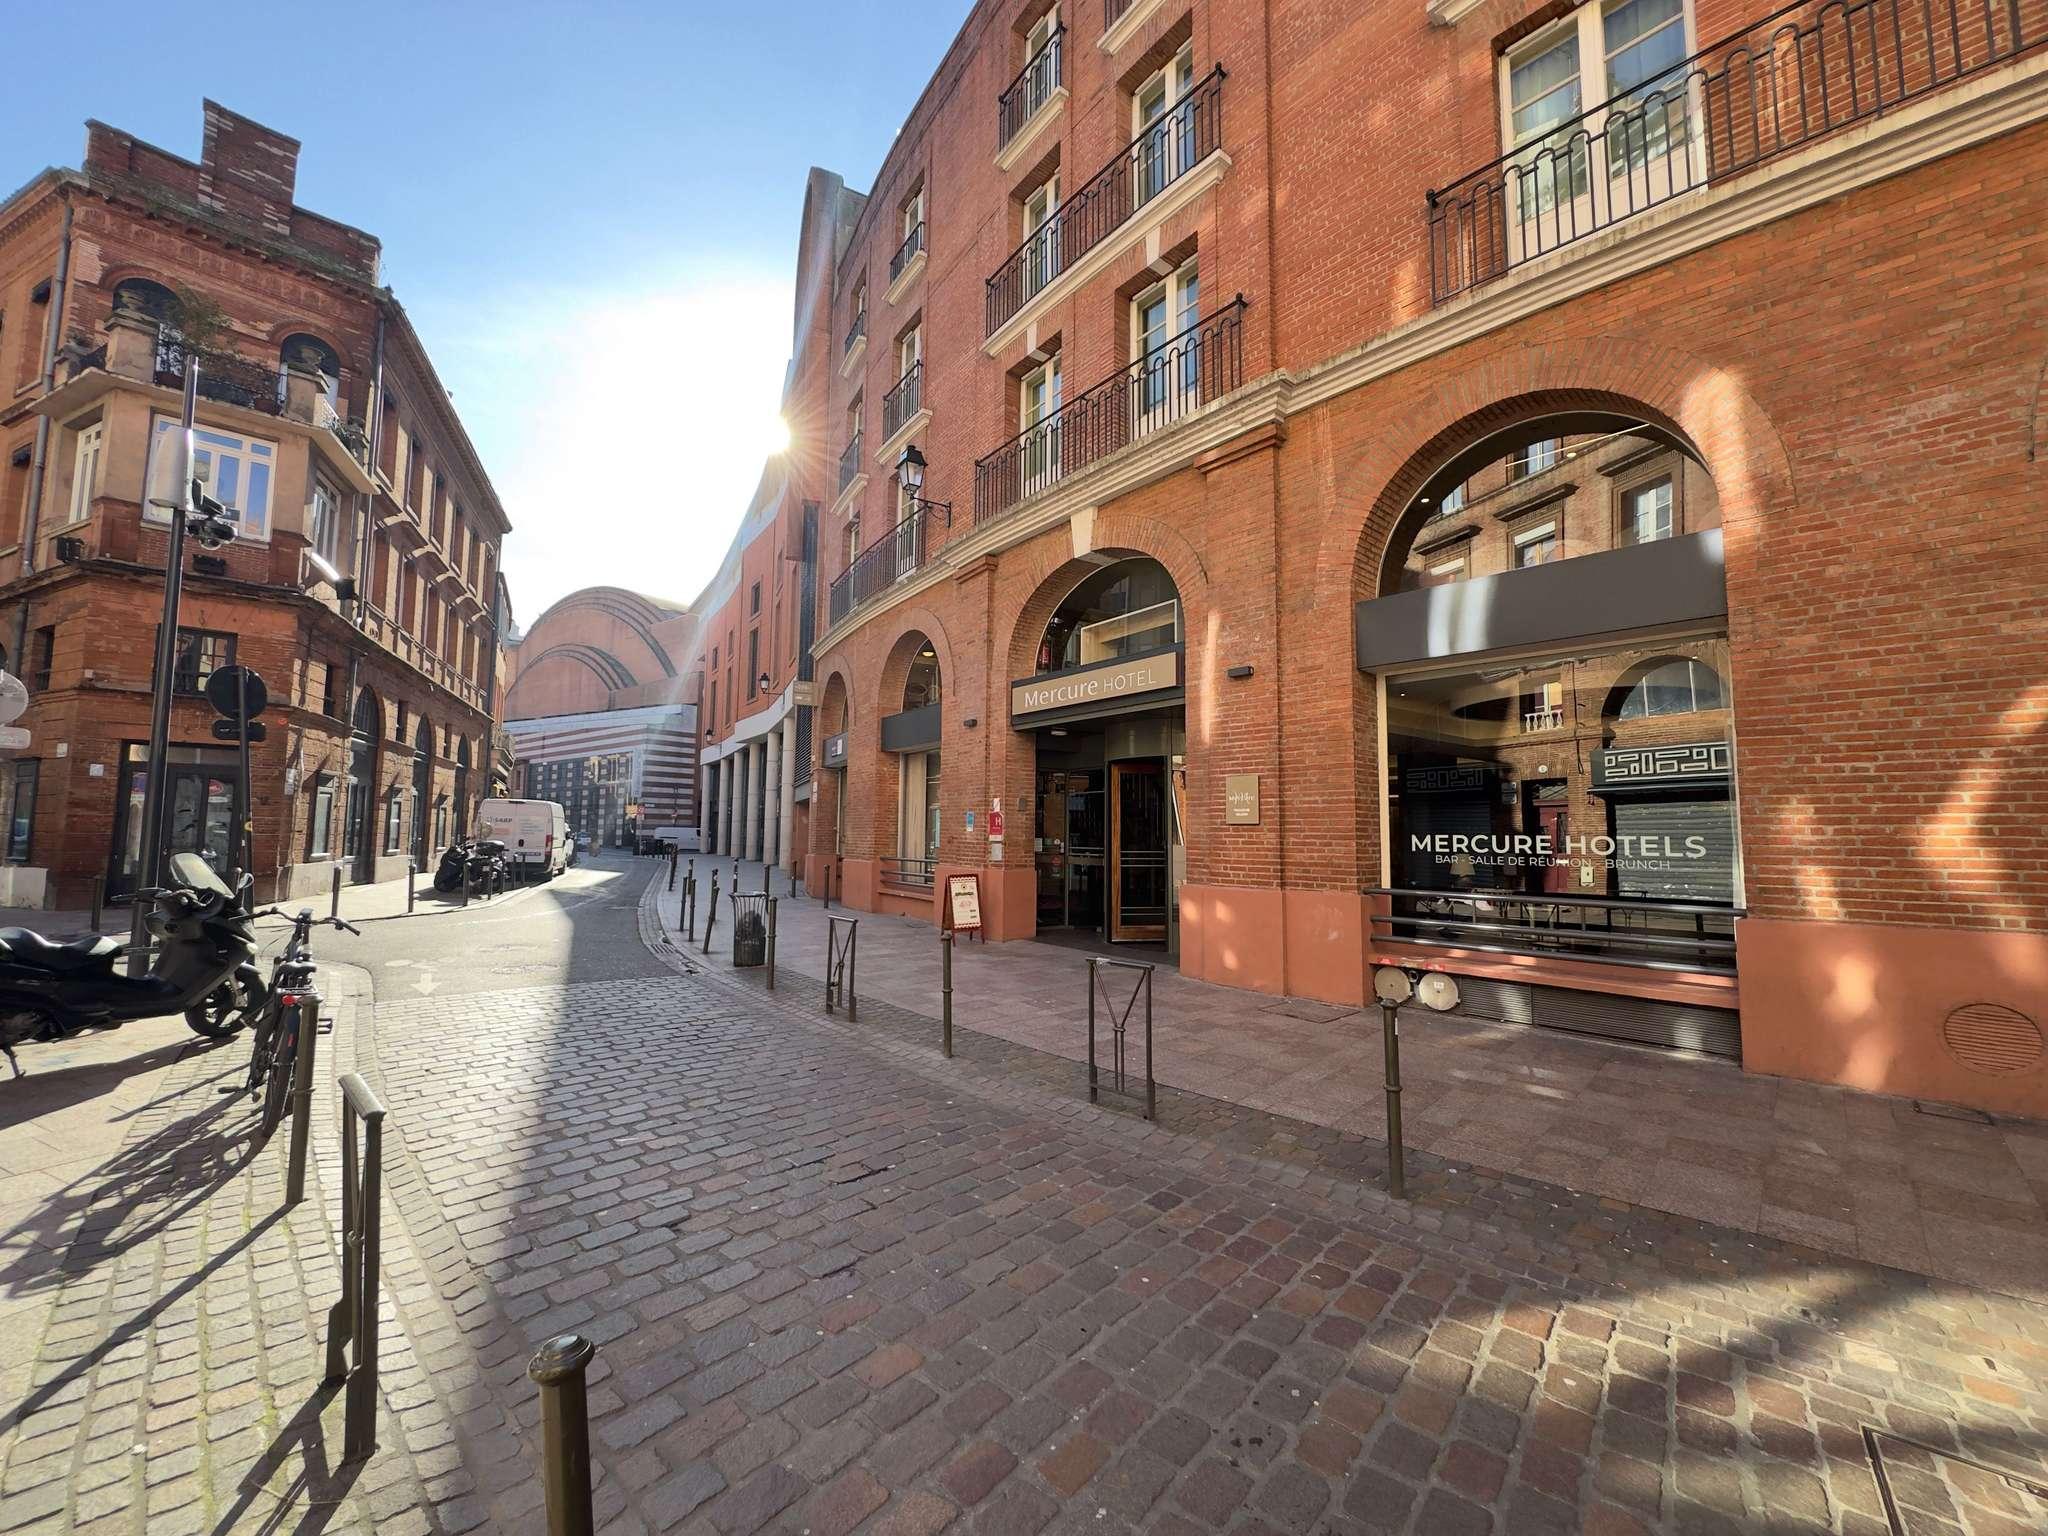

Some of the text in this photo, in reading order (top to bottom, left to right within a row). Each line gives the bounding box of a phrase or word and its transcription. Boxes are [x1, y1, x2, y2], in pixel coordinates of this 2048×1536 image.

[1024, 668, 1157, 708] Mercure HOTEL
[1411, 834, 1707, 859] MERCURE HOTELS
[1435, 855, 1459, 865] BAR
[1468, 855, 1505, 866] SALLE
[1508, 856, 1526, 867] DE
[1605, 859, 1671, 870] BRUNCH
